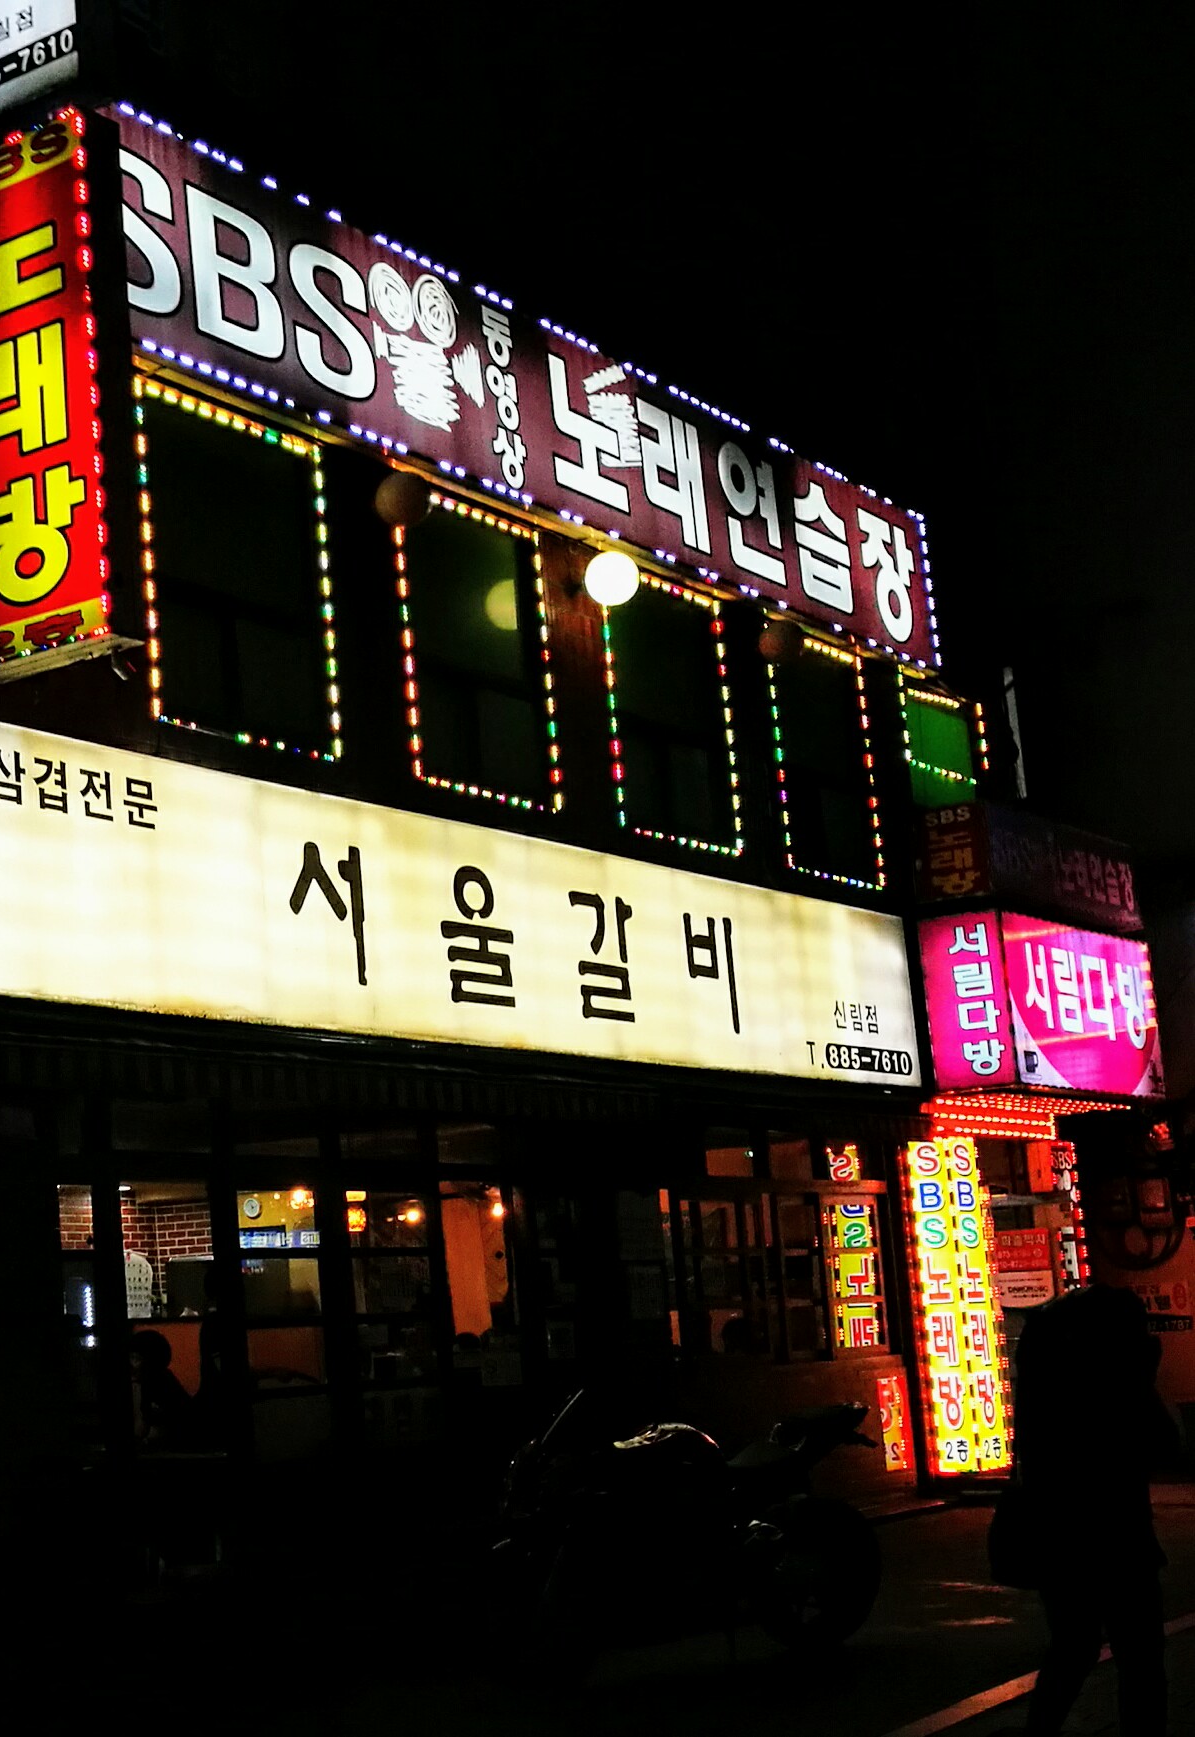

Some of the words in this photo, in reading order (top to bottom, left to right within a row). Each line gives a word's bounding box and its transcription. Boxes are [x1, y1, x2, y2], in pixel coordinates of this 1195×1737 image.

[118, 147, 378, 401] SBS
[547, 352, 915, 643] 노래연습장
[925, 805, 971, 828] SBS
[928, 830, 981, 895] 노래방
[289, 841, 740, 1035] 서울갈비
[833, 1000, 880, 1035] 신림점
[948, 922, 1005, 1076] 서림다방
[1024, 941, 1147, 1050] 서림다방
[806, 1040, 910, 1075] T.885-7610
[915, 1144, 948, 1249] SBS
[953, 1144, 980, 1249] SBS
[921, 1253, 965, 1431] 노래방
[959, 1253, 998, 1429] 노래방
[945, 1438, 969, 1463] 2층
[983, 1437, 1003, 1461] 2층
